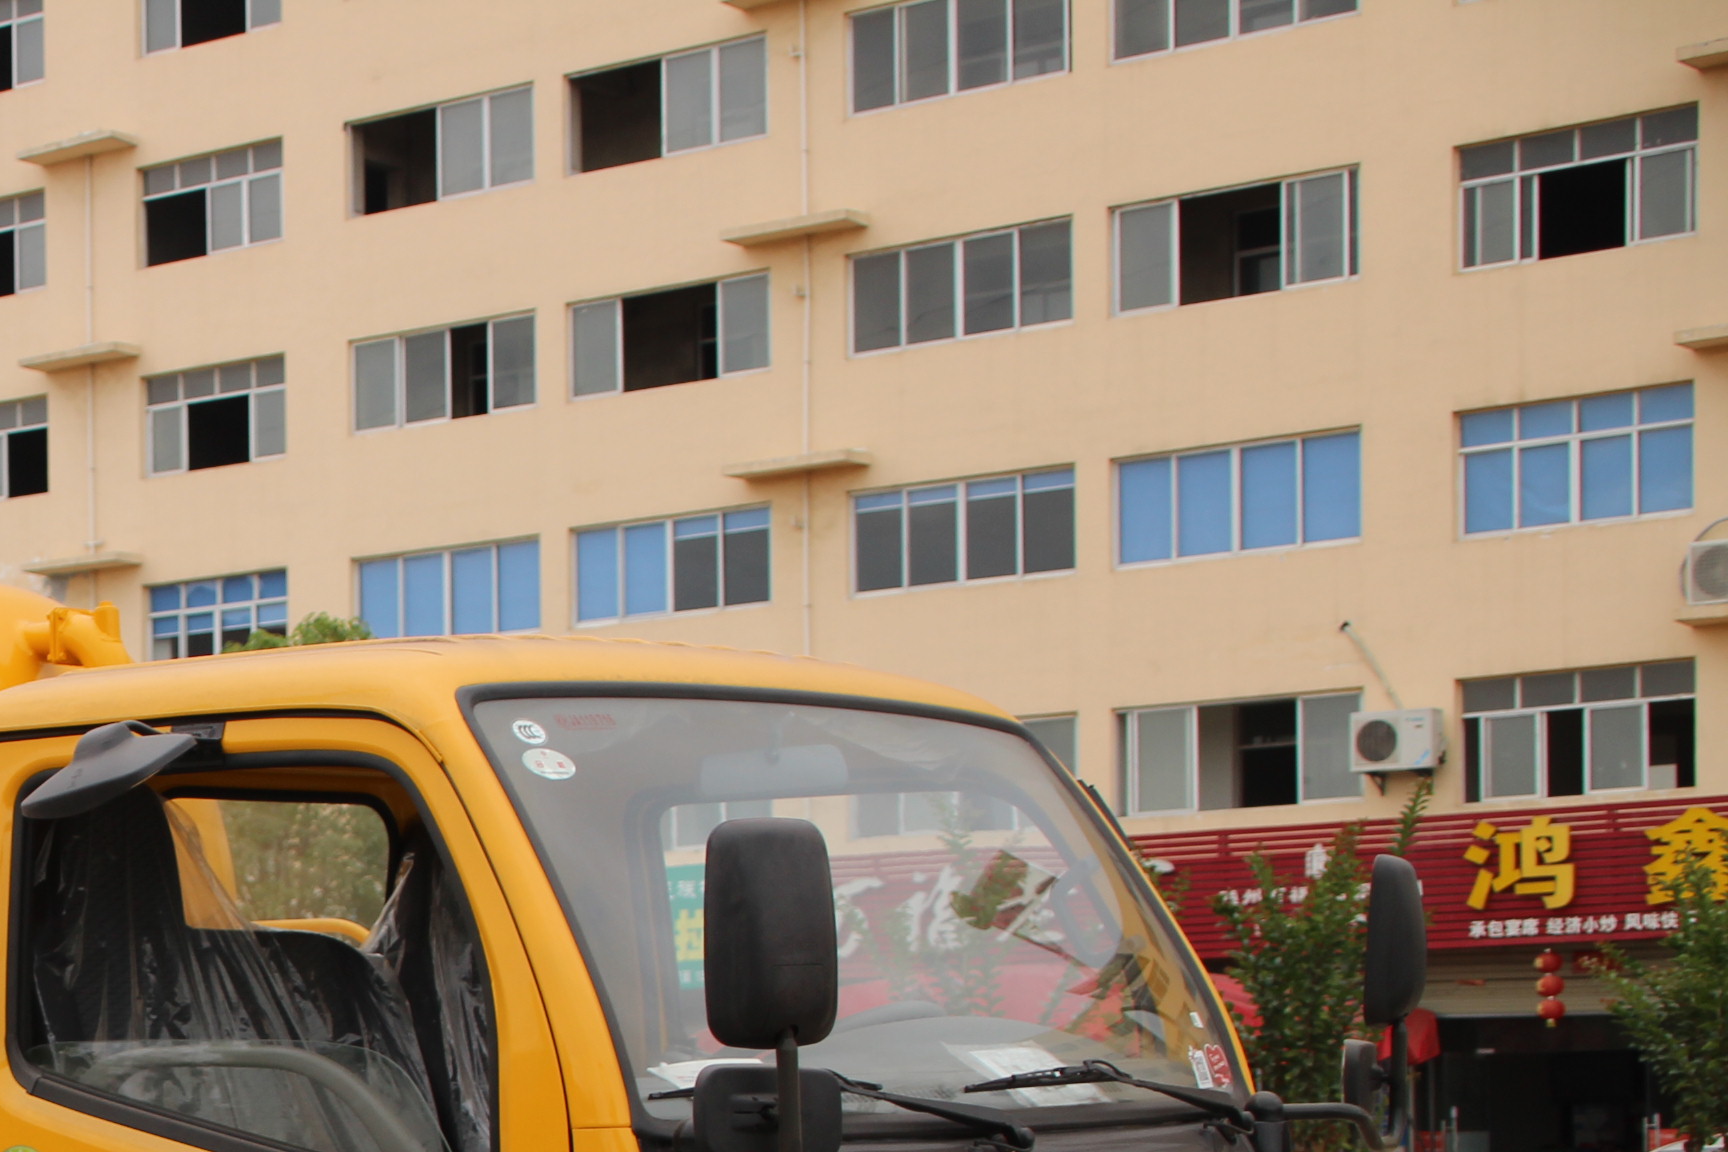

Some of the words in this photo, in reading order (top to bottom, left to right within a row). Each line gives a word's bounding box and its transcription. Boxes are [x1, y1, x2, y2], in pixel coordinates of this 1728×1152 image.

[1469, 917, 1539, 939] 承包宴席
[1546, 914, 1618, 936] 经济小炒
